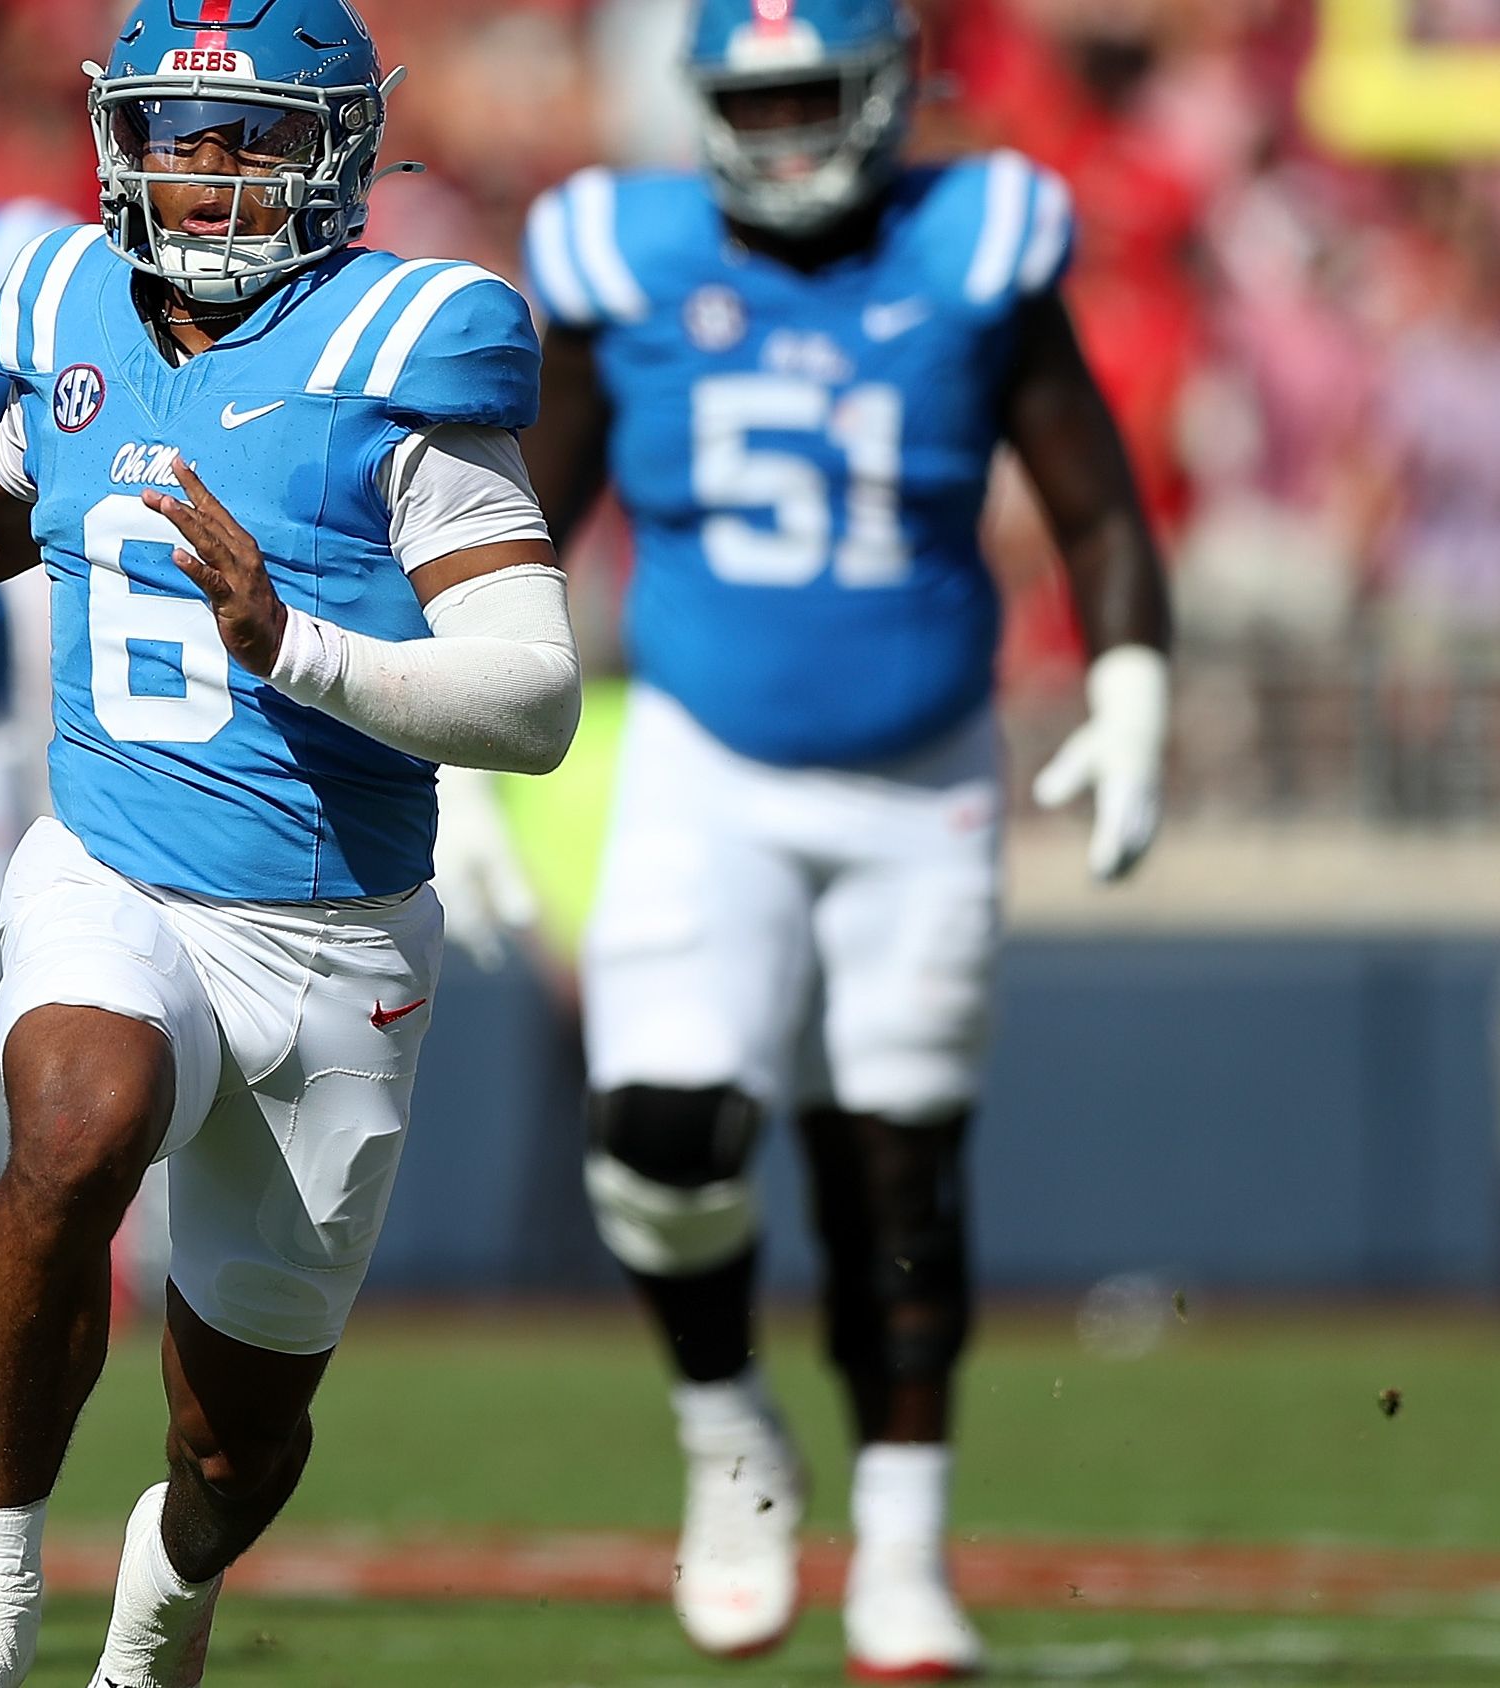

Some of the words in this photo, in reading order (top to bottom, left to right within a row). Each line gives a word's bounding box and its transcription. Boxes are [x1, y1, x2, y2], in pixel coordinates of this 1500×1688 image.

[172, 51, 237, 72] REBS
[55, 368, 101, 427] SEC
[689, 372, 910, 589] 51
[83, 492, 234, 743] 6
